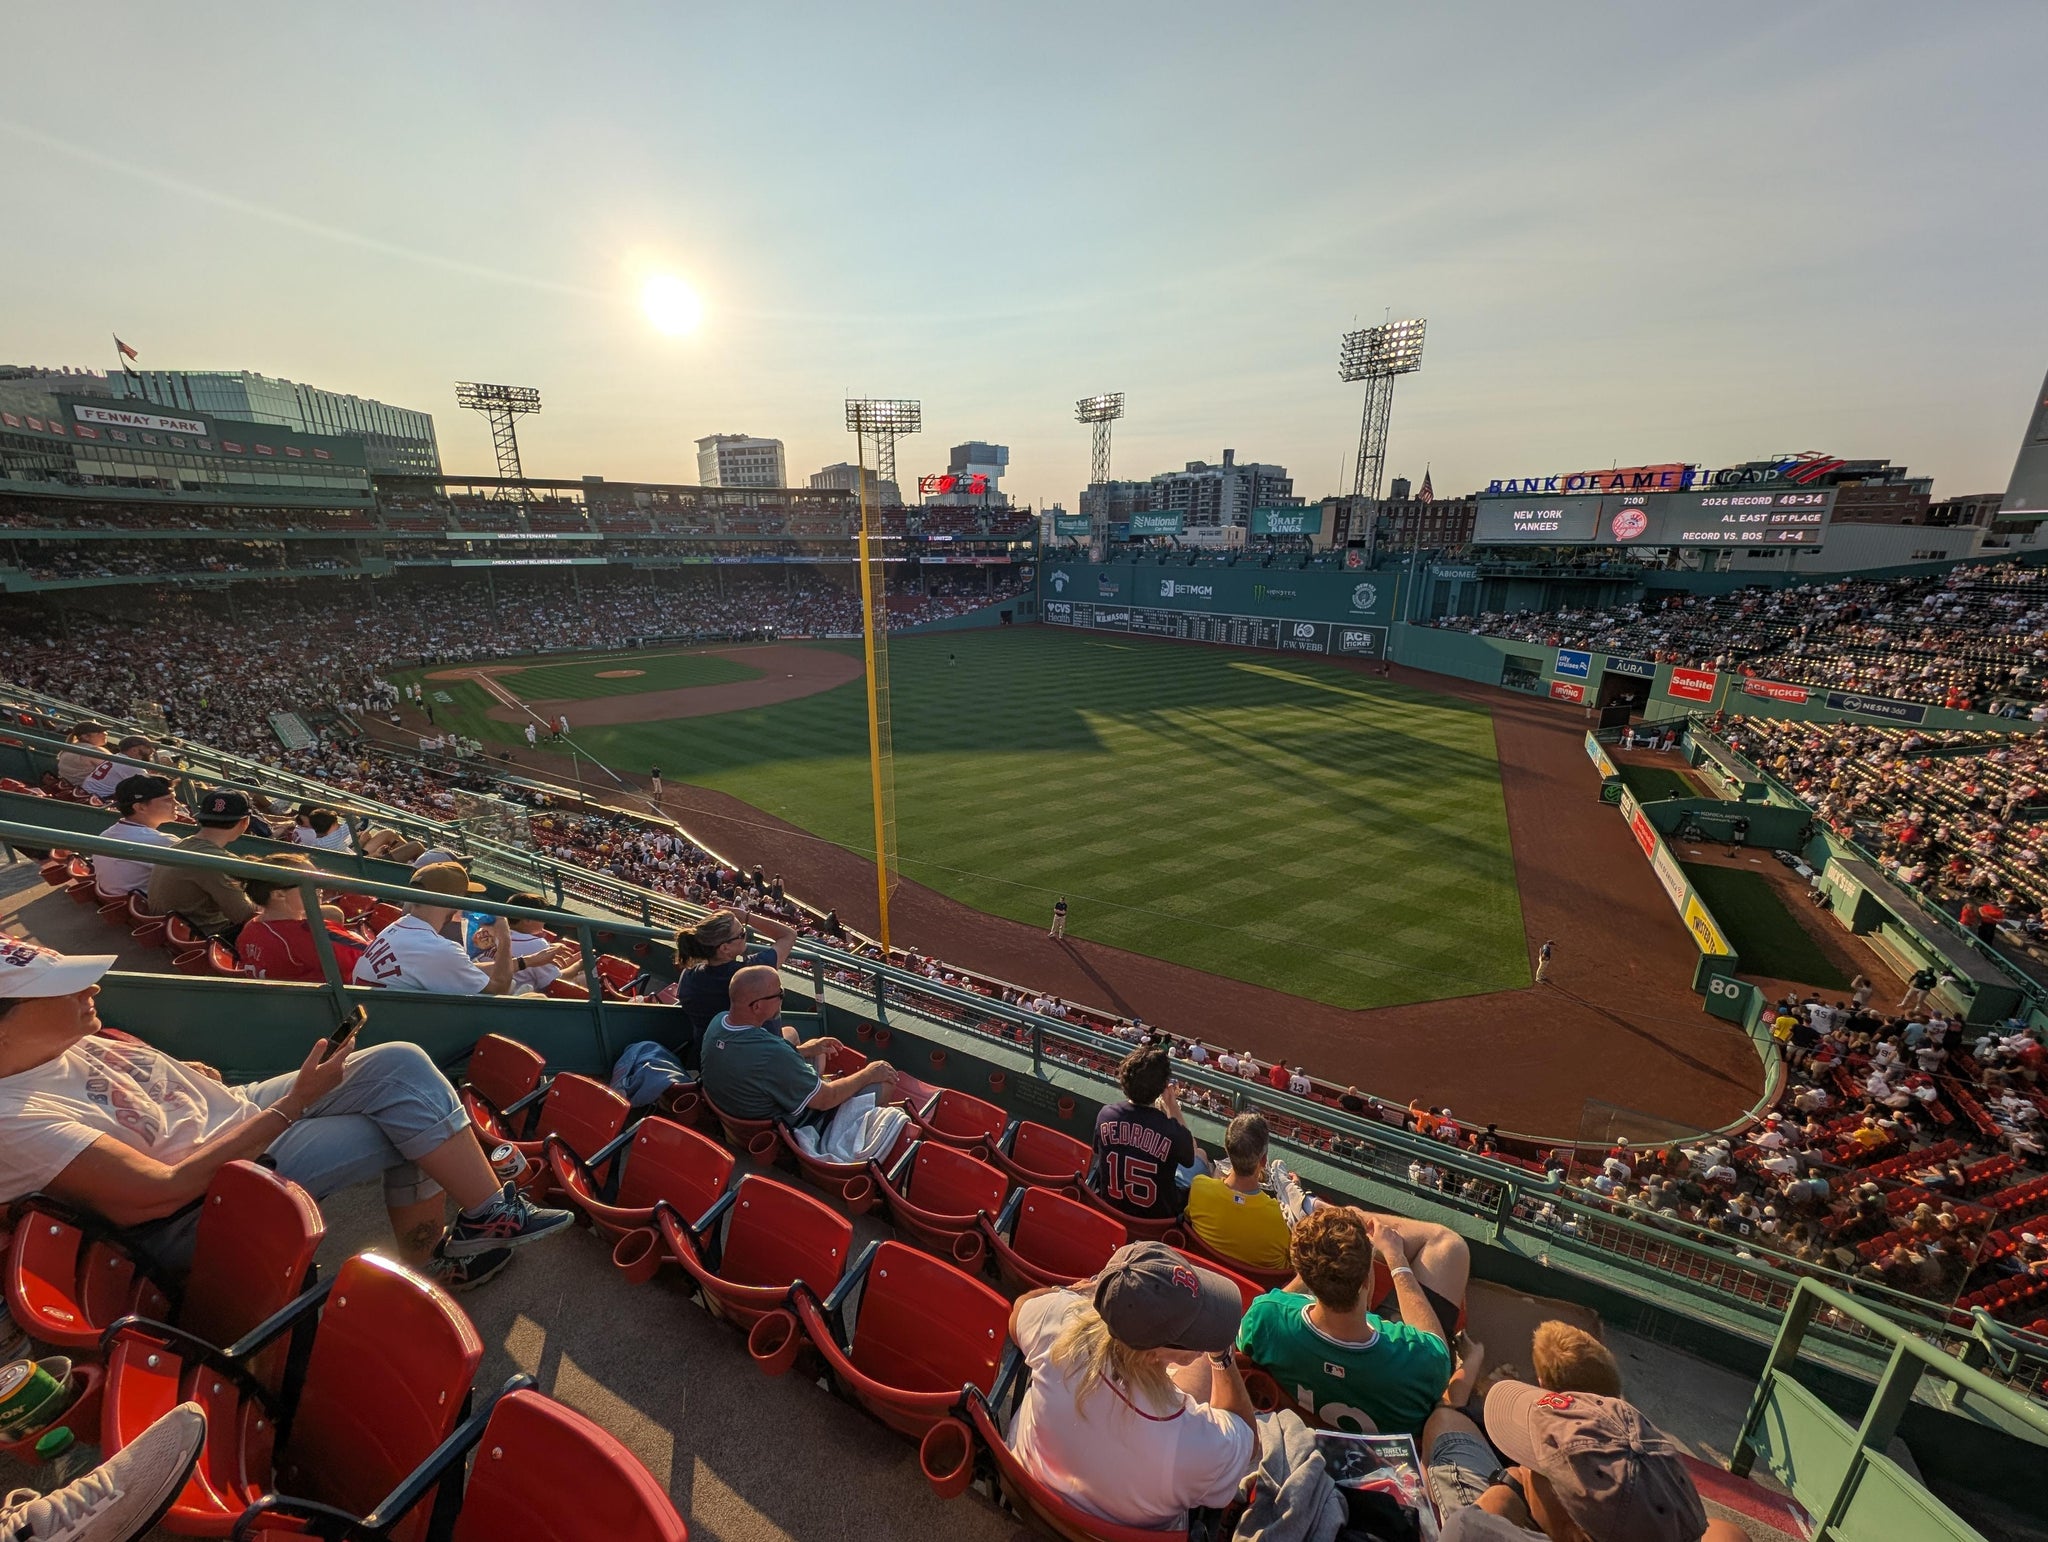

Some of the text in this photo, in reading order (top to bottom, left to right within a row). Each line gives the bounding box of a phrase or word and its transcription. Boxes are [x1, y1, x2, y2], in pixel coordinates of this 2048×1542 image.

[84, 409, 199, 432] FENWAY PARK
[1489, 475, 1560, 494] BANK
[1567, 474, 1600, 491] OF
[1610, 468, 1757, 489] AMERICA
[1623, 497, 1644, 505] 7:00
[1702, 498, 1728, 506] 2026
[1731, 497, 1772, 506] RECORD
[1267, 514, 1304, 527] DRAFT
[1513, 510, 1563, 520] NEW YORK
[1721, 514, 1736, 522] AL
[1739, 513, 1768, 522] EAST
[1788, 513, 1822, 522] PLACE
[1143, 515, 1178, 527] National
[1513, 522, 1559, 531] YANKEES
[1270, 524, 1302, 533] KINGS
[1682, 531, 1804, 541] RECORD VS. BOS 4-4
[1175, 584, 1213, 596] BETMGM
[1054, 603, 1071, 614] CVS
[1047, 612, 1071, 623] Health
[1293, 623, 1315, 638] 160
[1345, 631, 1371, 642] ACE
[1298, 641, 1323, 652] WEBB
[1345, 640, 1372, 648] TICKET
[1559, 655, 1571, 664] city
[1558, 661, 1579, 670] cruises
[1672, 676, 1713, 690] Safelite
[1555, 686, 1578, 698] IRVING
[1767, 687, 1807, 698] TICKET
[1862, 702, 1906, 716] NESN 360
[212, 798, 226, 813] B
[1709, 979, 1740, 999] 80
[1814, 1008, 1827, 1019] 45
[1100, 1120, 1172, 1162] PEDROIA
[1106, 1151, 1158, 1208] 15
[1739, 1222, 1750, 1235] 8
[1172, 1265, 1199, 1298] B
[1537, 1391, 1575, 1410] B
